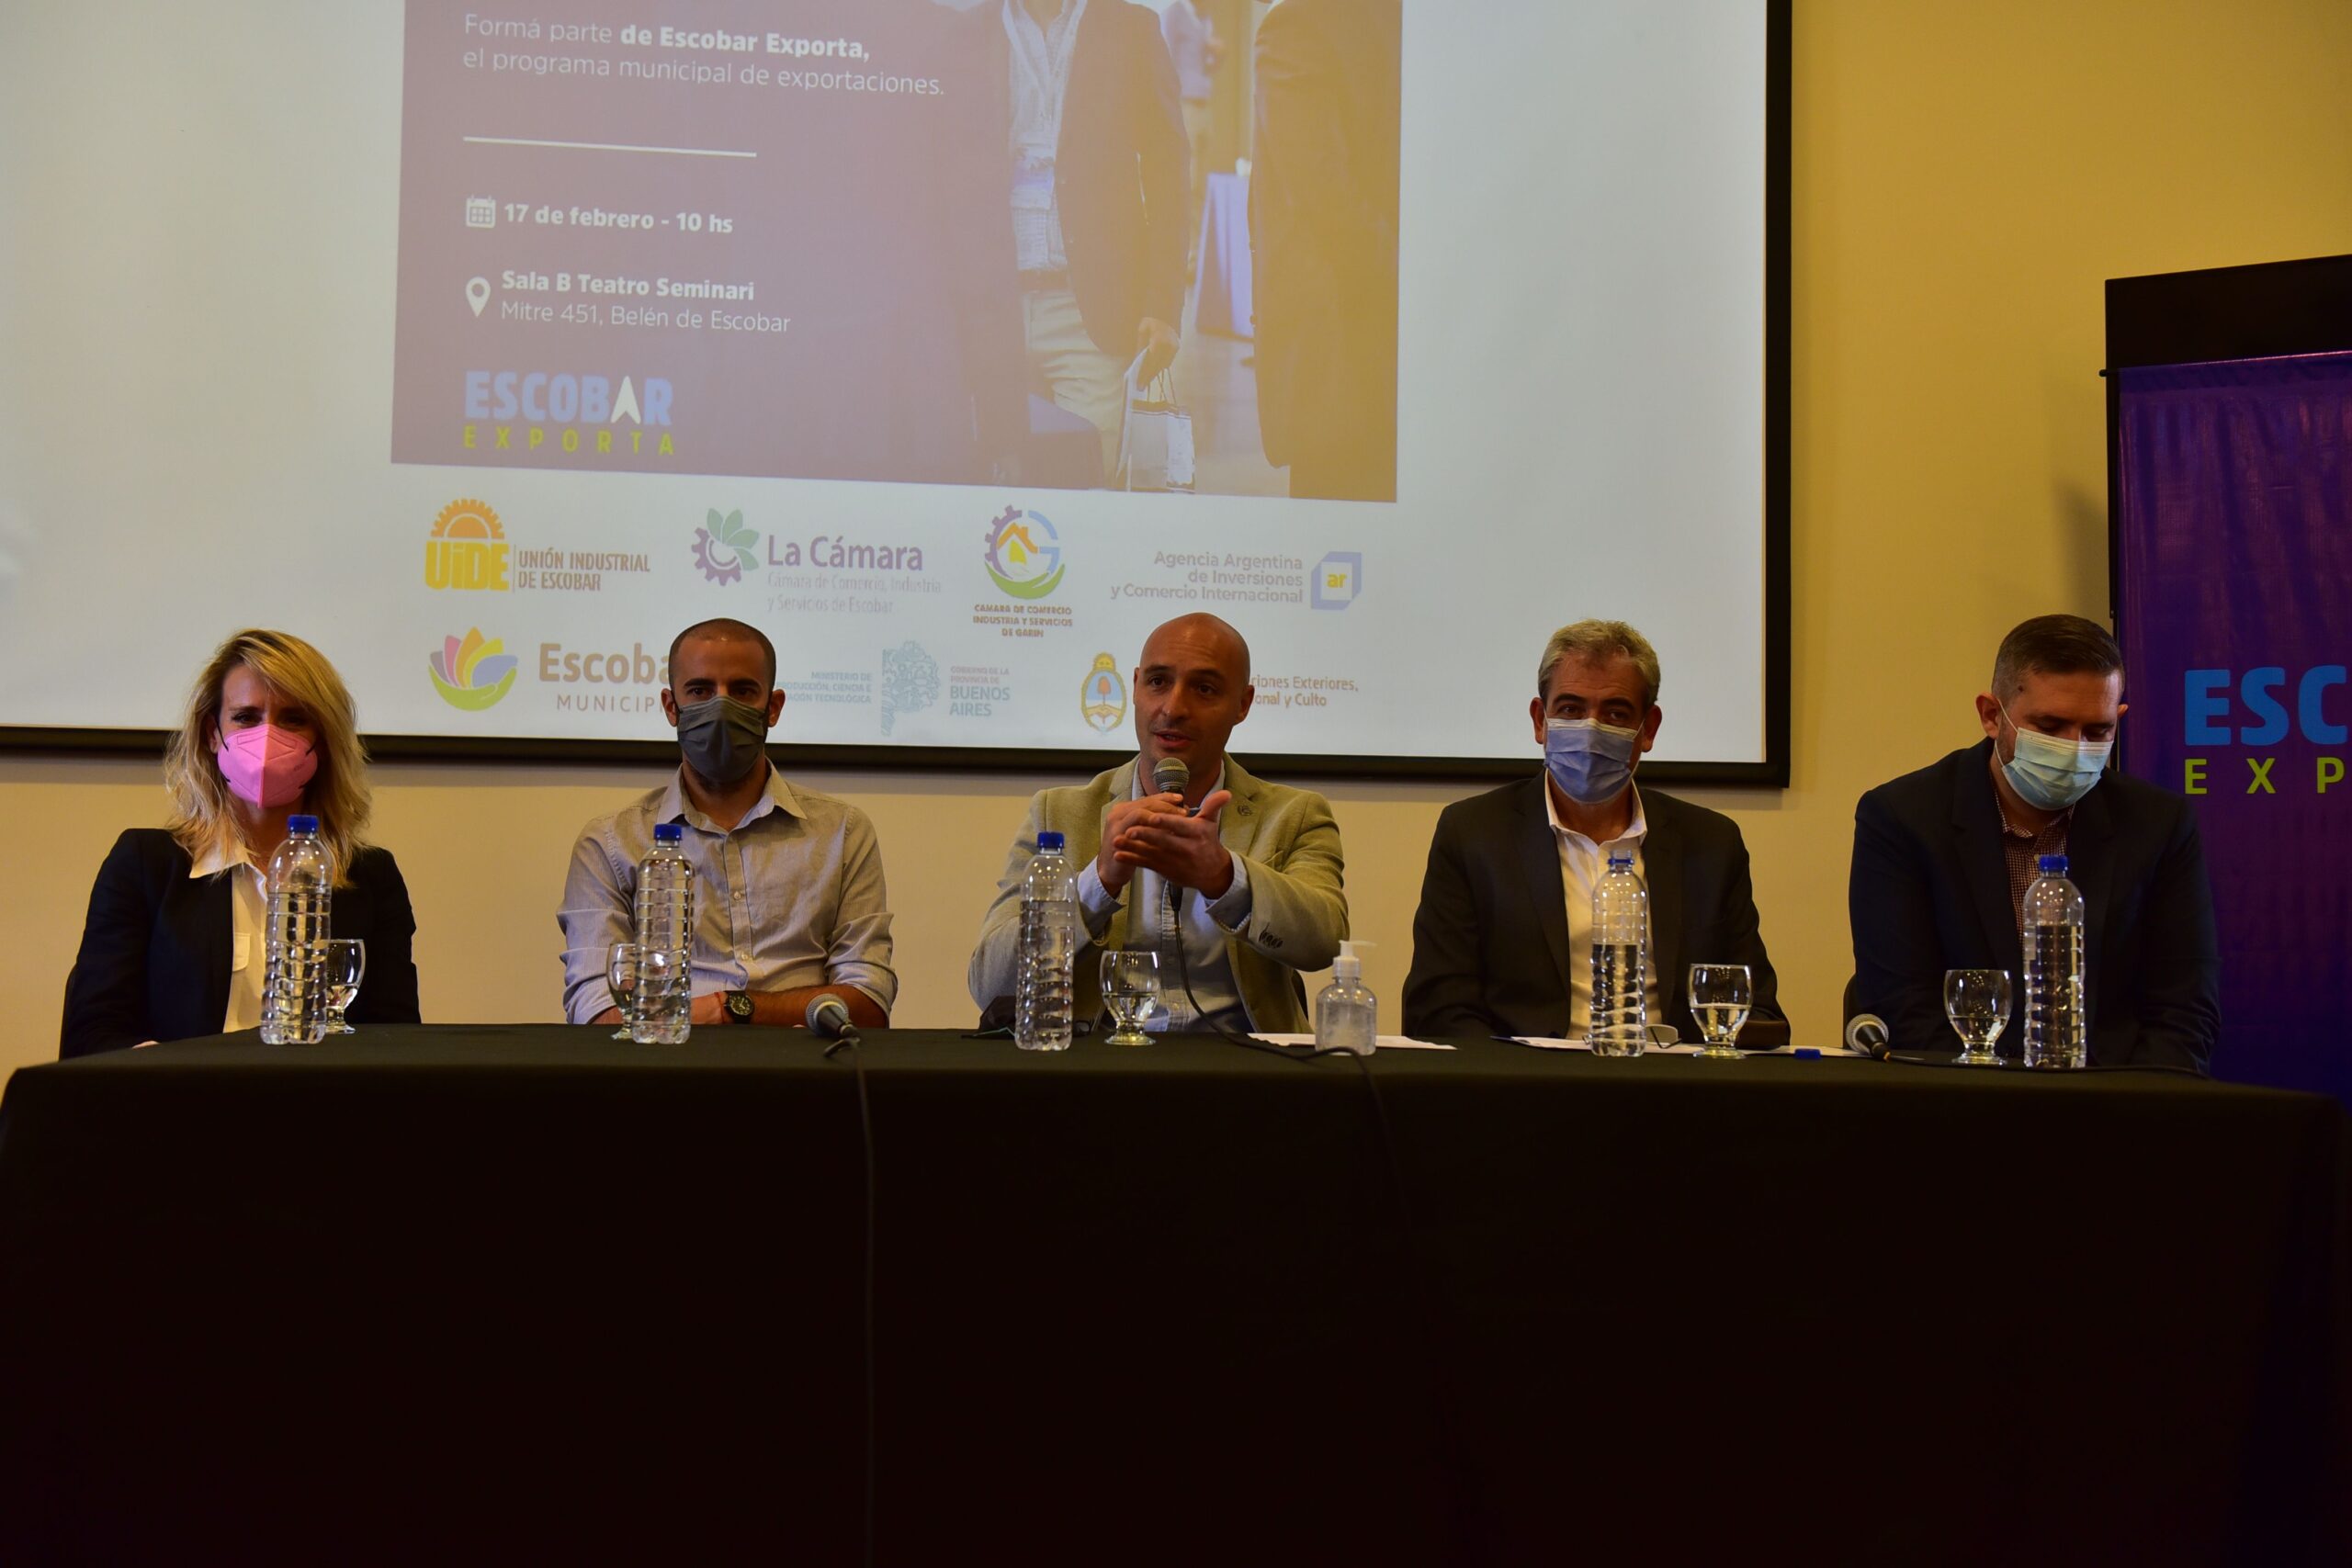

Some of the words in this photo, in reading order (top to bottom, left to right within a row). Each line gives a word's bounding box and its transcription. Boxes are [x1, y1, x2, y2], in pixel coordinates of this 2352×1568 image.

[465, 13, 540, 39] Formá
[549, 22, 612, 43] parte
[620, 24, 652, 45] de
[660, 26, 757, 52] Escobar
[766, 32, 870, 62] Exporta,
[463, 48, 484, 68] el
[492, 52, 610, 75] programa
[619, 59, 731, 84] municipal
[740, 63, 769, 85] de
[777, 70, 944, 95] exportaciones.
[504, 203, 528, 223] 17
[535, 206, 563, 224] de
[569, 207, 654, 230] febrero
[676, 212, 702, 231] 10
[709, 214, 733, 233] hs
[502, 270, 548, 291] Sala
[556, 273, 571, 292] B
[577, 274, 650, 296] Teatro
[656, 277, 755, 300] Seminari
[502, 300, 553, 321] Mitre
[560, 303, 604, 327] 451,
[611, 305, 670, 327] Belén
[676, 308, 703, 328] de
[710, 310, 791, 333] Escobar
[465, 370, 673, 426] ESCOBAR
[463, 423, 674, 456] EXPORTA
[518, 547, 564, 570] UNIÓN
[570, 551, 650, 572] INDUSTRIAL
[768, 535, 801, 566] La
[809, 535, 922, 571] Cámara
[1154, 551, 1219, 569] Agencia
[1224, 554, 1303, 571] Argentina
[518, 571, 536, 589] DE
[541, 572, 601, 592] ESCOBAR
[768, 571, 811, 589] Cámara
[815, 573, 829, 589] de
[890, 575, 941, 593] Industria
[1188, 570, 1208, 583] de
[1213, 570, 1303, 586] Inversiones
[1327, 573, 1347, 589] ar
[1111, 585, 1120, 600] y
[1124, 583, 1198, 599] Comercio
[1202, 586, 1303, 604] Internacional
[768, 597, 774, 612] y
[777, 595, 828, 611] Servicios
[831, 598, 846, 612] de
[849, 597, 894, 614] Escobar
[1013, 605, 1024, 614] DE
[973, 615, 1020, 625] INDUSTRIA
[1029, 617, 1073, 626] SERVICIOS
[1001, 628, 1013, 637] DE
[557, 694, 662, 713] MUNICIP
[950, 685, 1011, 701] BUENOS
[1284, 695, 1292, 708] y
[1295, 693, 1327, 706] Culto
[949, 702, 991, 716] AIRES
[2185, 665, 2348, 746] ESC
[2184, 757, 2345, 795] EXP
